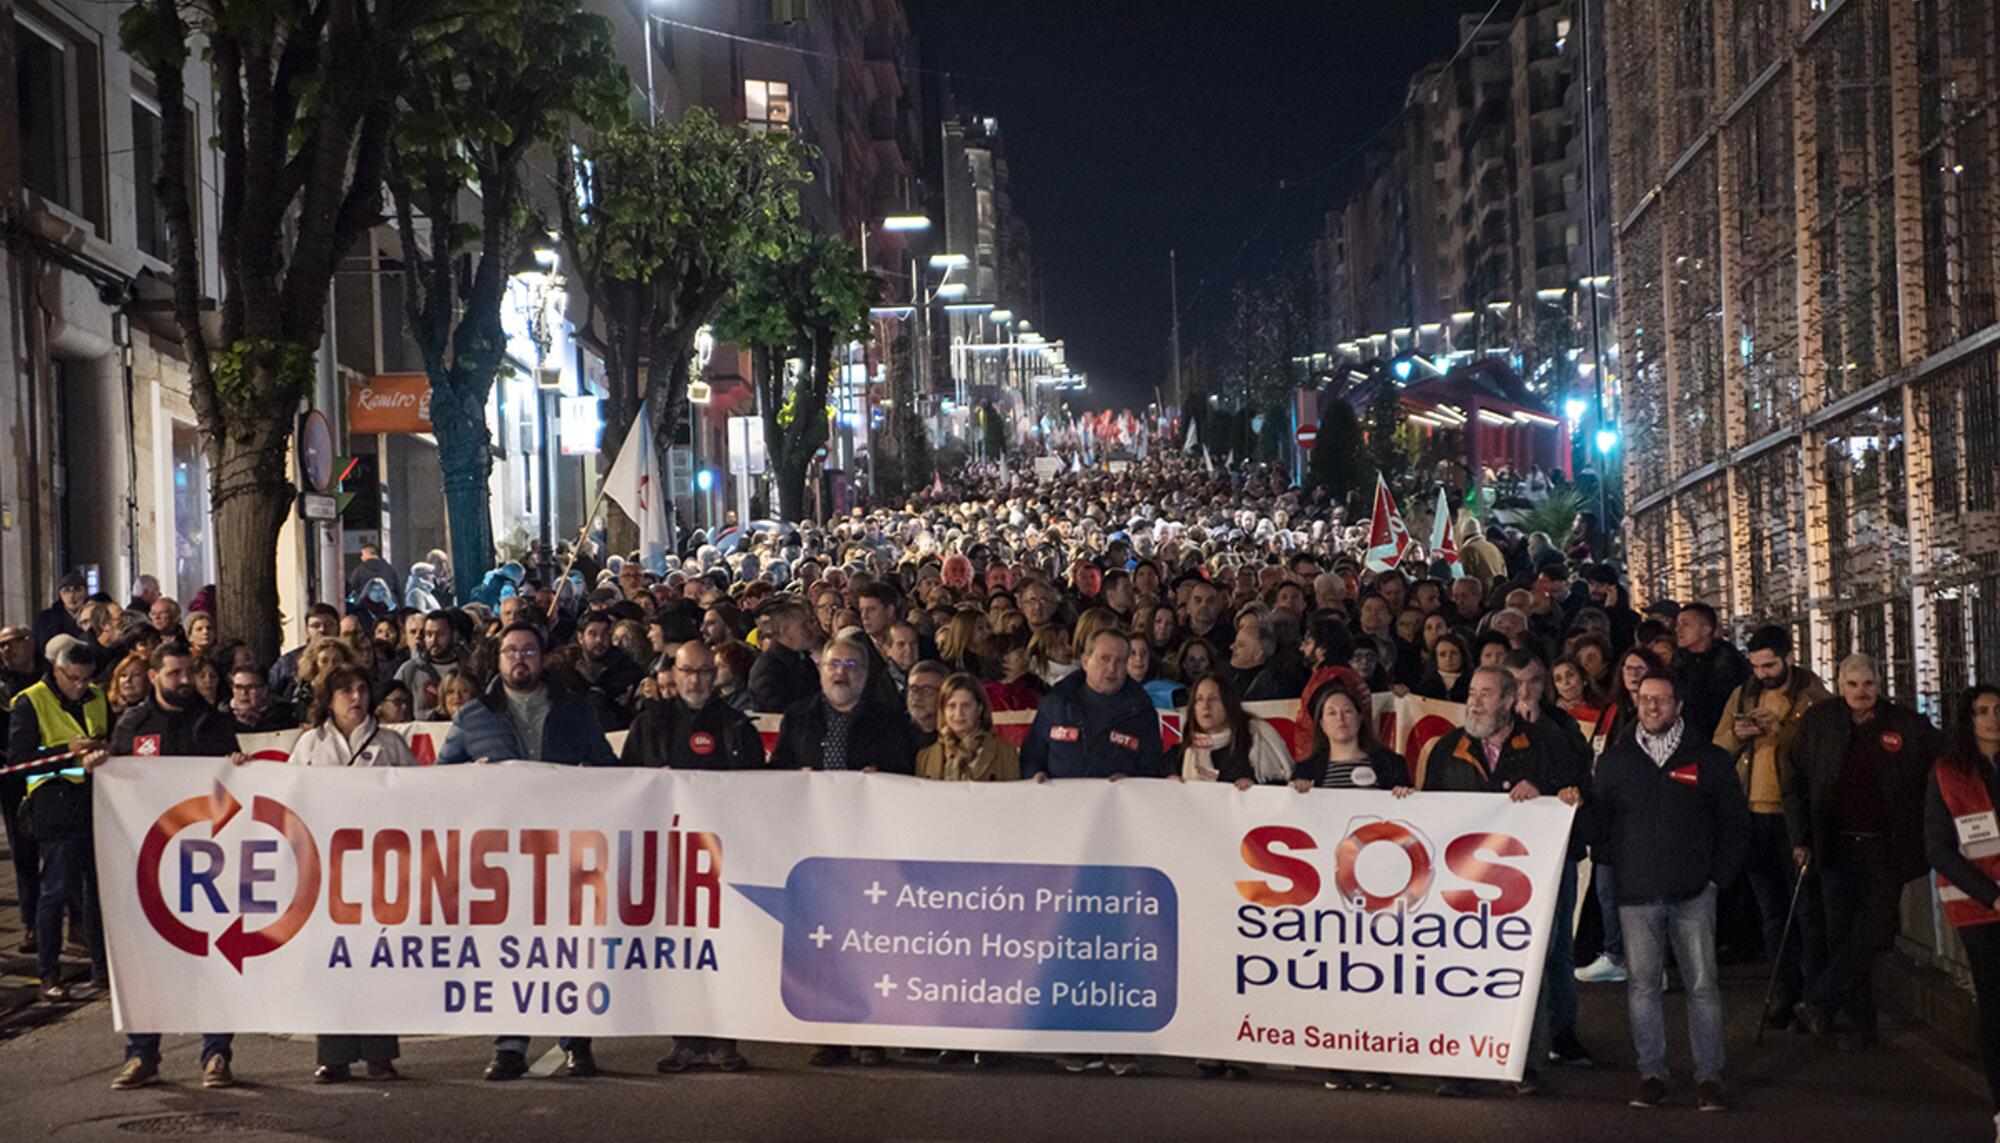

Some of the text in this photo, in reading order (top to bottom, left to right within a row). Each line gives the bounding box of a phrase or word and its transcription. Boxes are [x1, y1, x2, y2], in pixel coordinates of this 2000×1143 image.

[1109, 731, 1131, 746] UGT
[179, 814, 723, 929] RE CONSTRUÍR
[1234, 818, 1534, 916] SOS
[896, 884, 1026, 913] Atención
[1035, 887, 1160, 916] Primaria
[1236, 898, 1533, 951] sanidade
[328, 928, 719, 972] A ÁREA SANITARIA
[841, 928, 971, 957] Atención
[982, 932, 1158, 964] Hospitalaria
[906, 977, 1042, 1006] Sanidade
[1051, 979, 1158, 1008] Pública
[1236, 949, 1525, 999] pública
[444, 981, 611, 1016] DE VIGO
[1236, 1014, 1296, 1045] Área
[1303, 1025, 1420, 1054] Sanitaria
[1428, 1034, 1460, 1056] de
